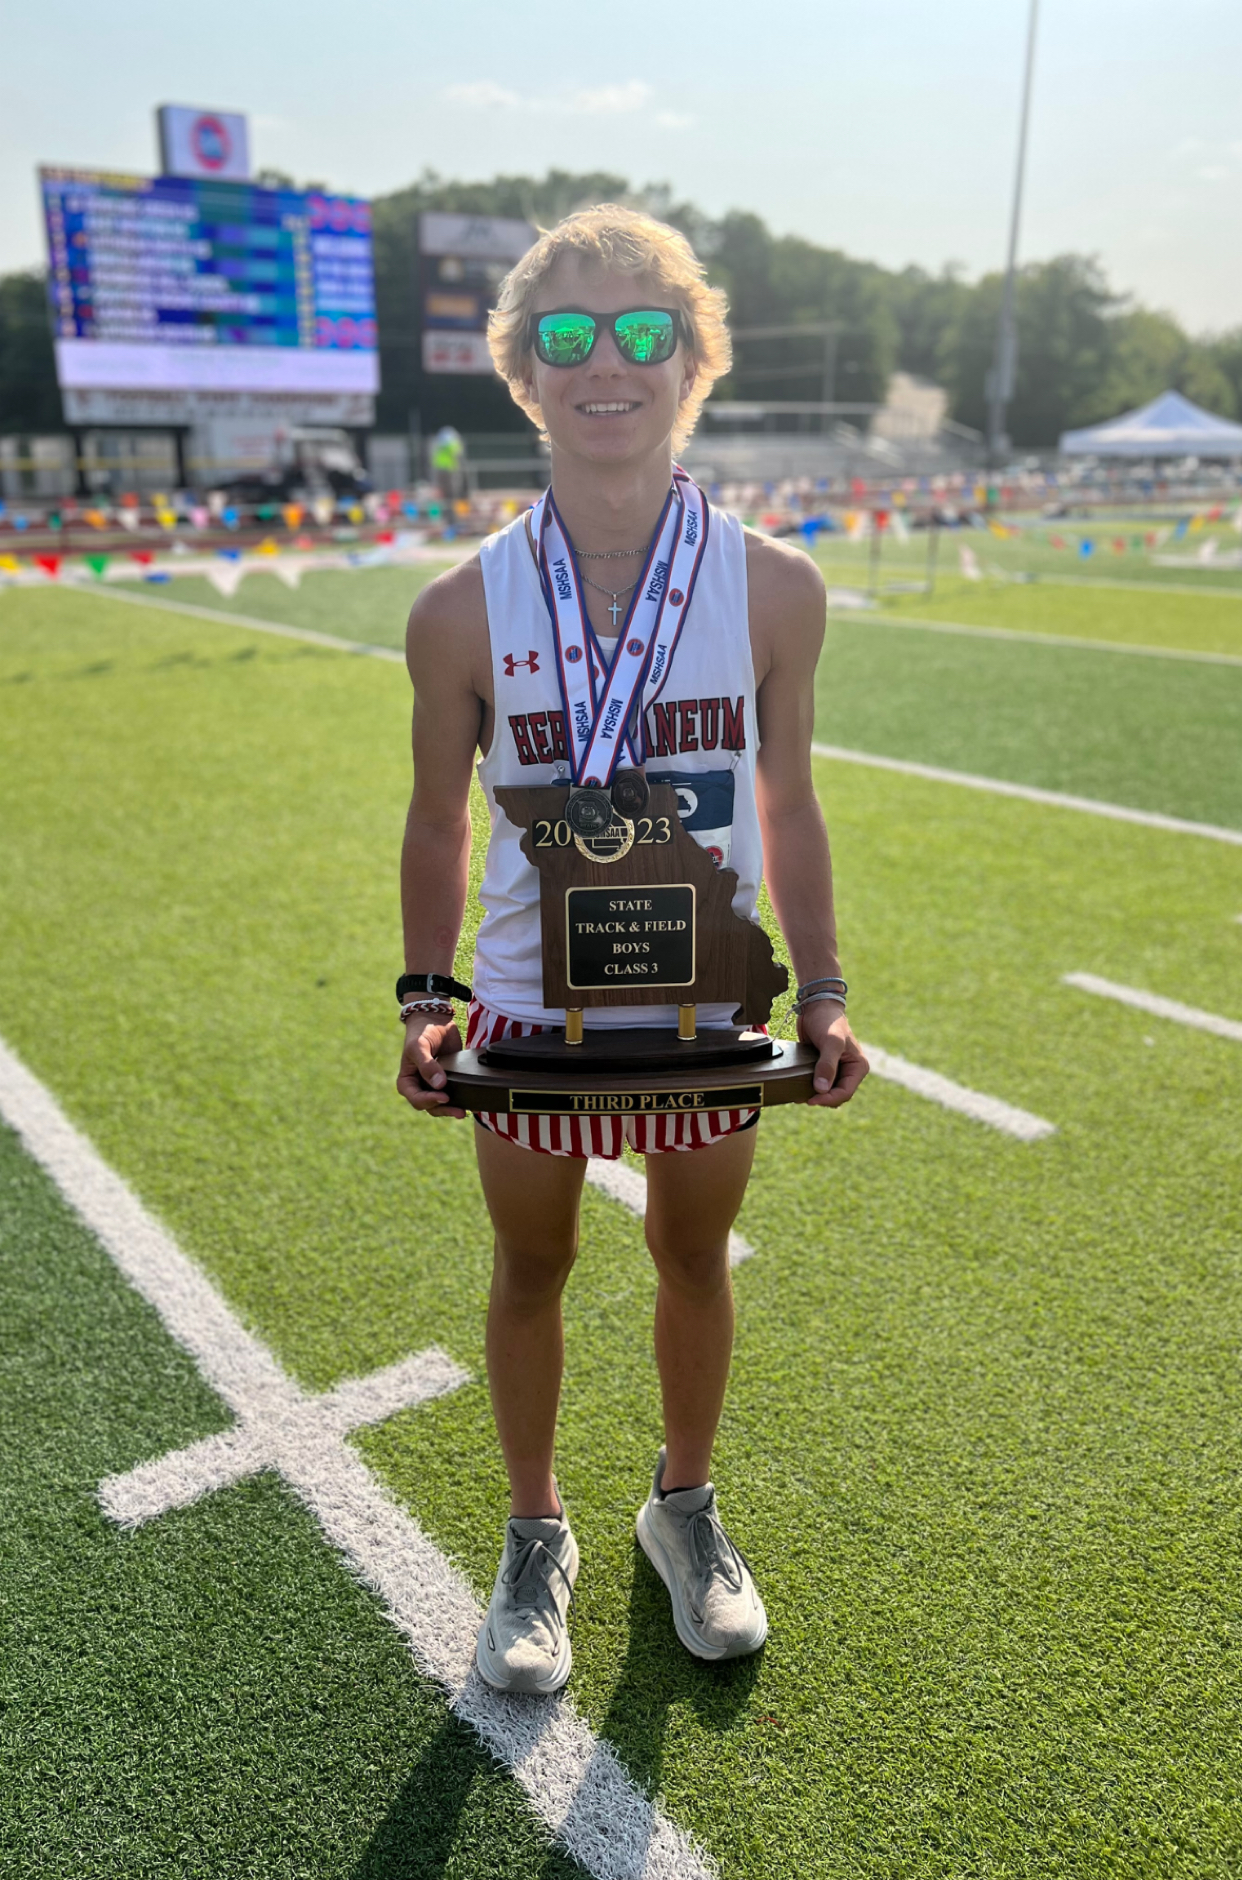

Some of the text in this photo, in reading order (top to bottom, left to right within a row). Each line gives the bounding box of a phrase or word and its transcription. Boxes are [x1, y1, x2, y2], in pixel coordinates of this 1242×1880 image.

[684, 509, 699, 547] MSHSAA
[553, 558, 573, 600] MSHSAA
[645, 560, 668, 602] MSHSAA
[650, 644, 667, 684] MSHSAA
[574, 700, 591, 742] MSHSAA
[600, 698, 624, 739] MSHSAA
[535, 817, 671, 847] 20 23
[609, 900, 653, 911] STATE
[575, 920, 687, 934] TRACK & FIELD
[612, 942, 650, 954] BOYS
[604, 963, 659, 975] CLASS 3
[570, 1093, 705, 1110] THIRD PLACE
